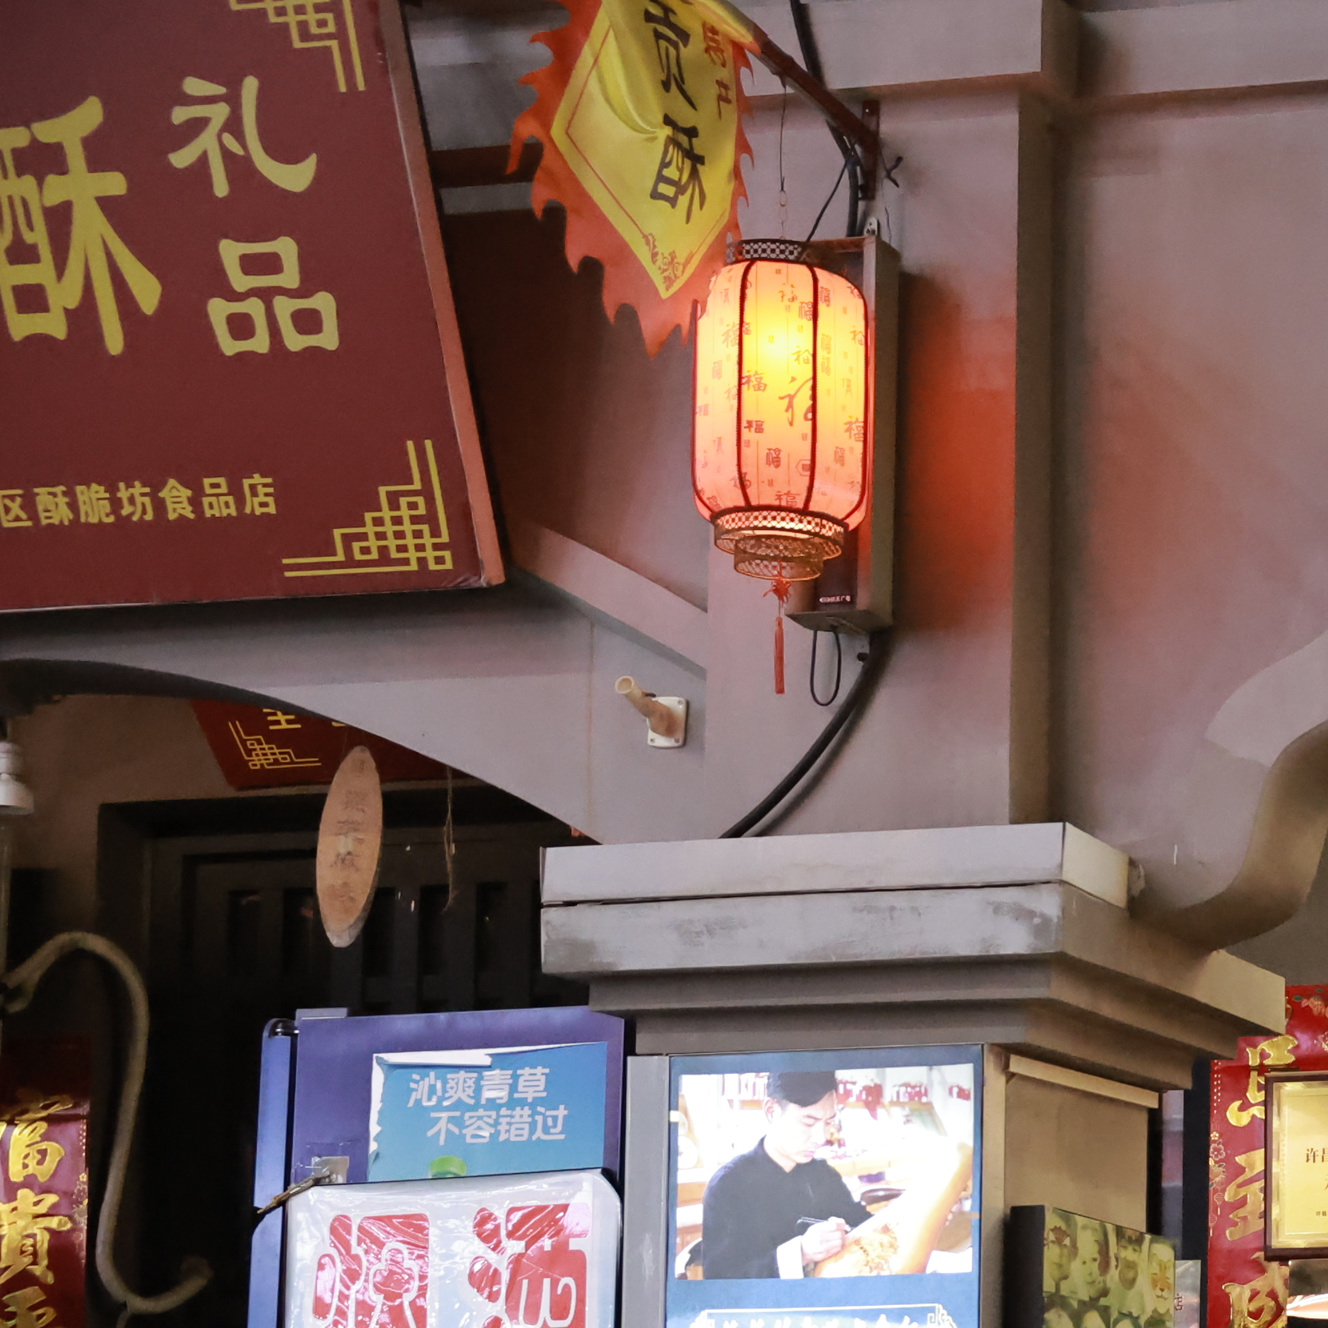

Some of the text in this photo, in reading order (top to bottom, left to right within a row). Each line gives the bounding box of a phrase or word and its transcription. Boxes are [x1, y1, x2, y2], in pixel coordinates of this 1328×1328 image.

[0, 96, 162, 355] 酥
[168, 75, 340, 355] 礼品
[0, 474, 279, 529] 区酥脆坊食品店
[407, 1066, 548, 1109] 沁爽青草
[427, 1104, 569, 1146] 不容错过
